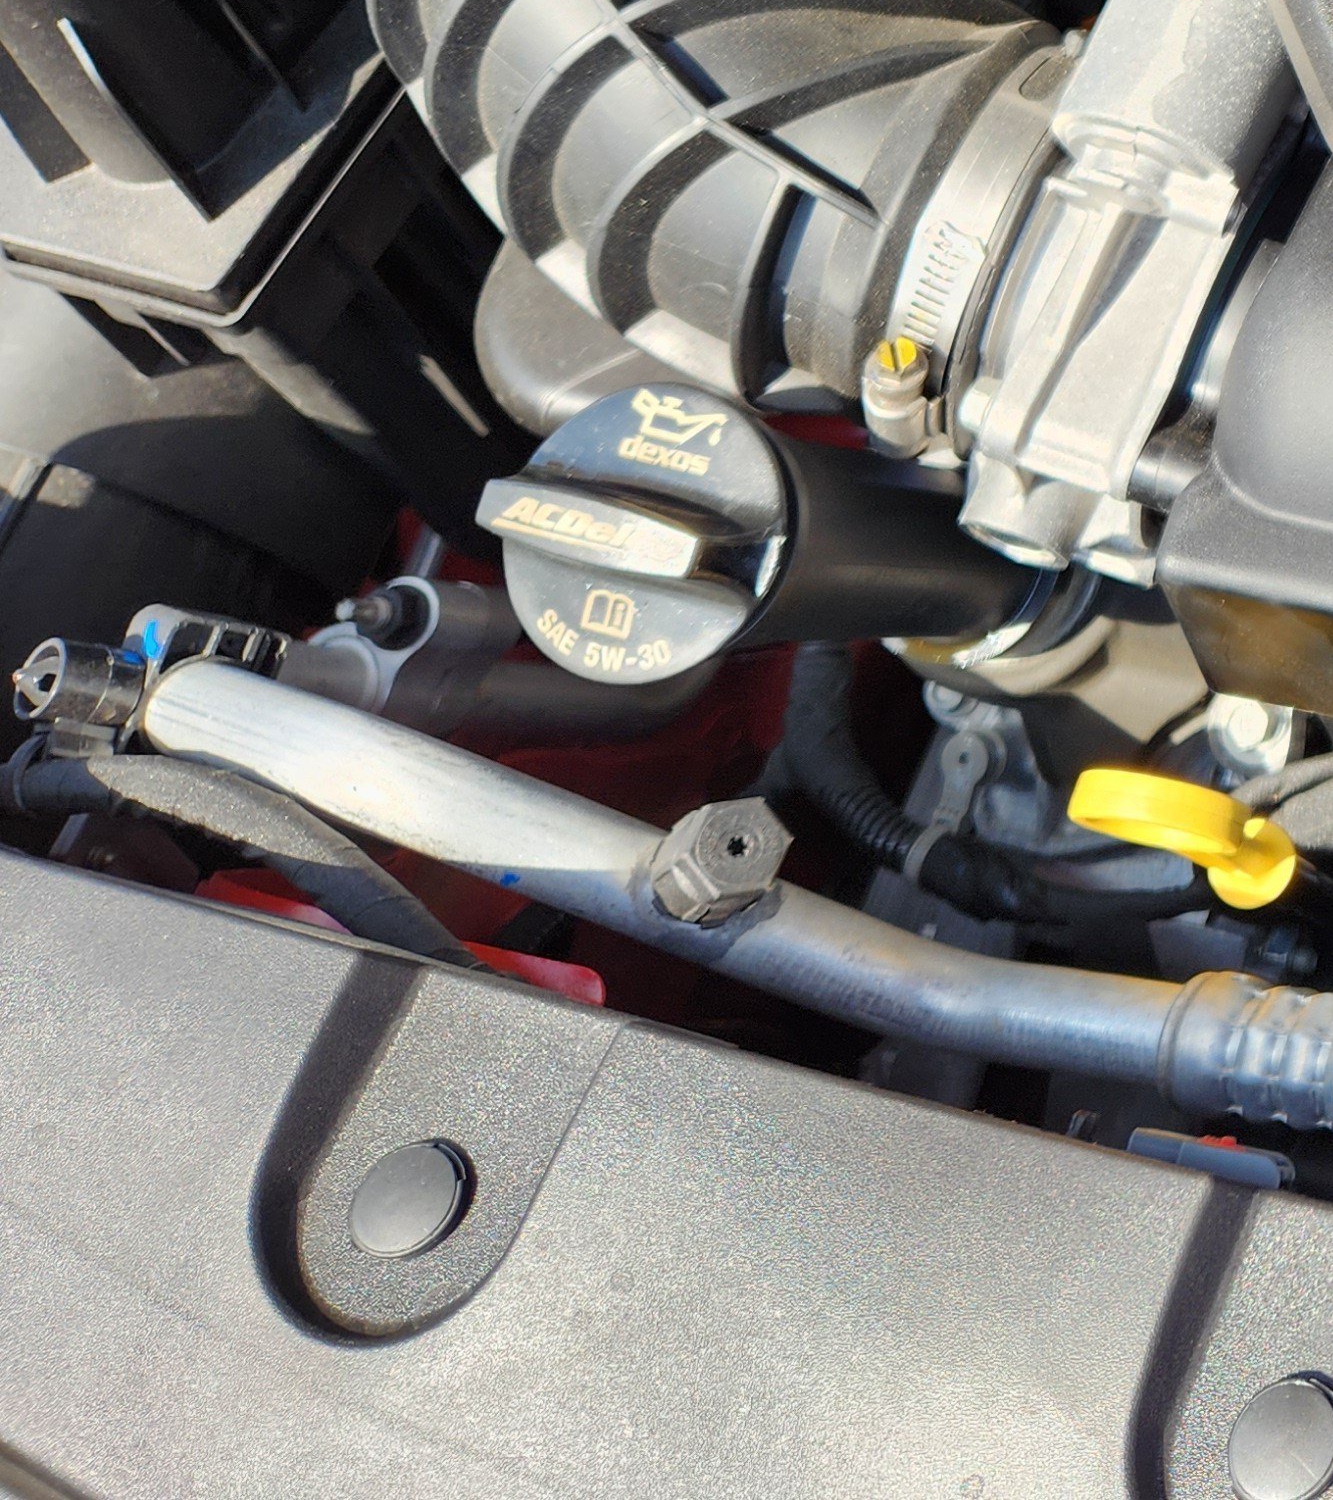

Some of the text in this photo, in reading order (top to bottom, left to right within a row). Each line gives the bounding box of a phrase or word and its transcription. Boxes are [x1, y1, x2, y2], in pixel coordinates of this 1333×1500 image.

[618, 436, 711, 476] dexos
[501, 496, 684, 563] ACDel
[536, 608, 672, 672] SAE 5W-30
